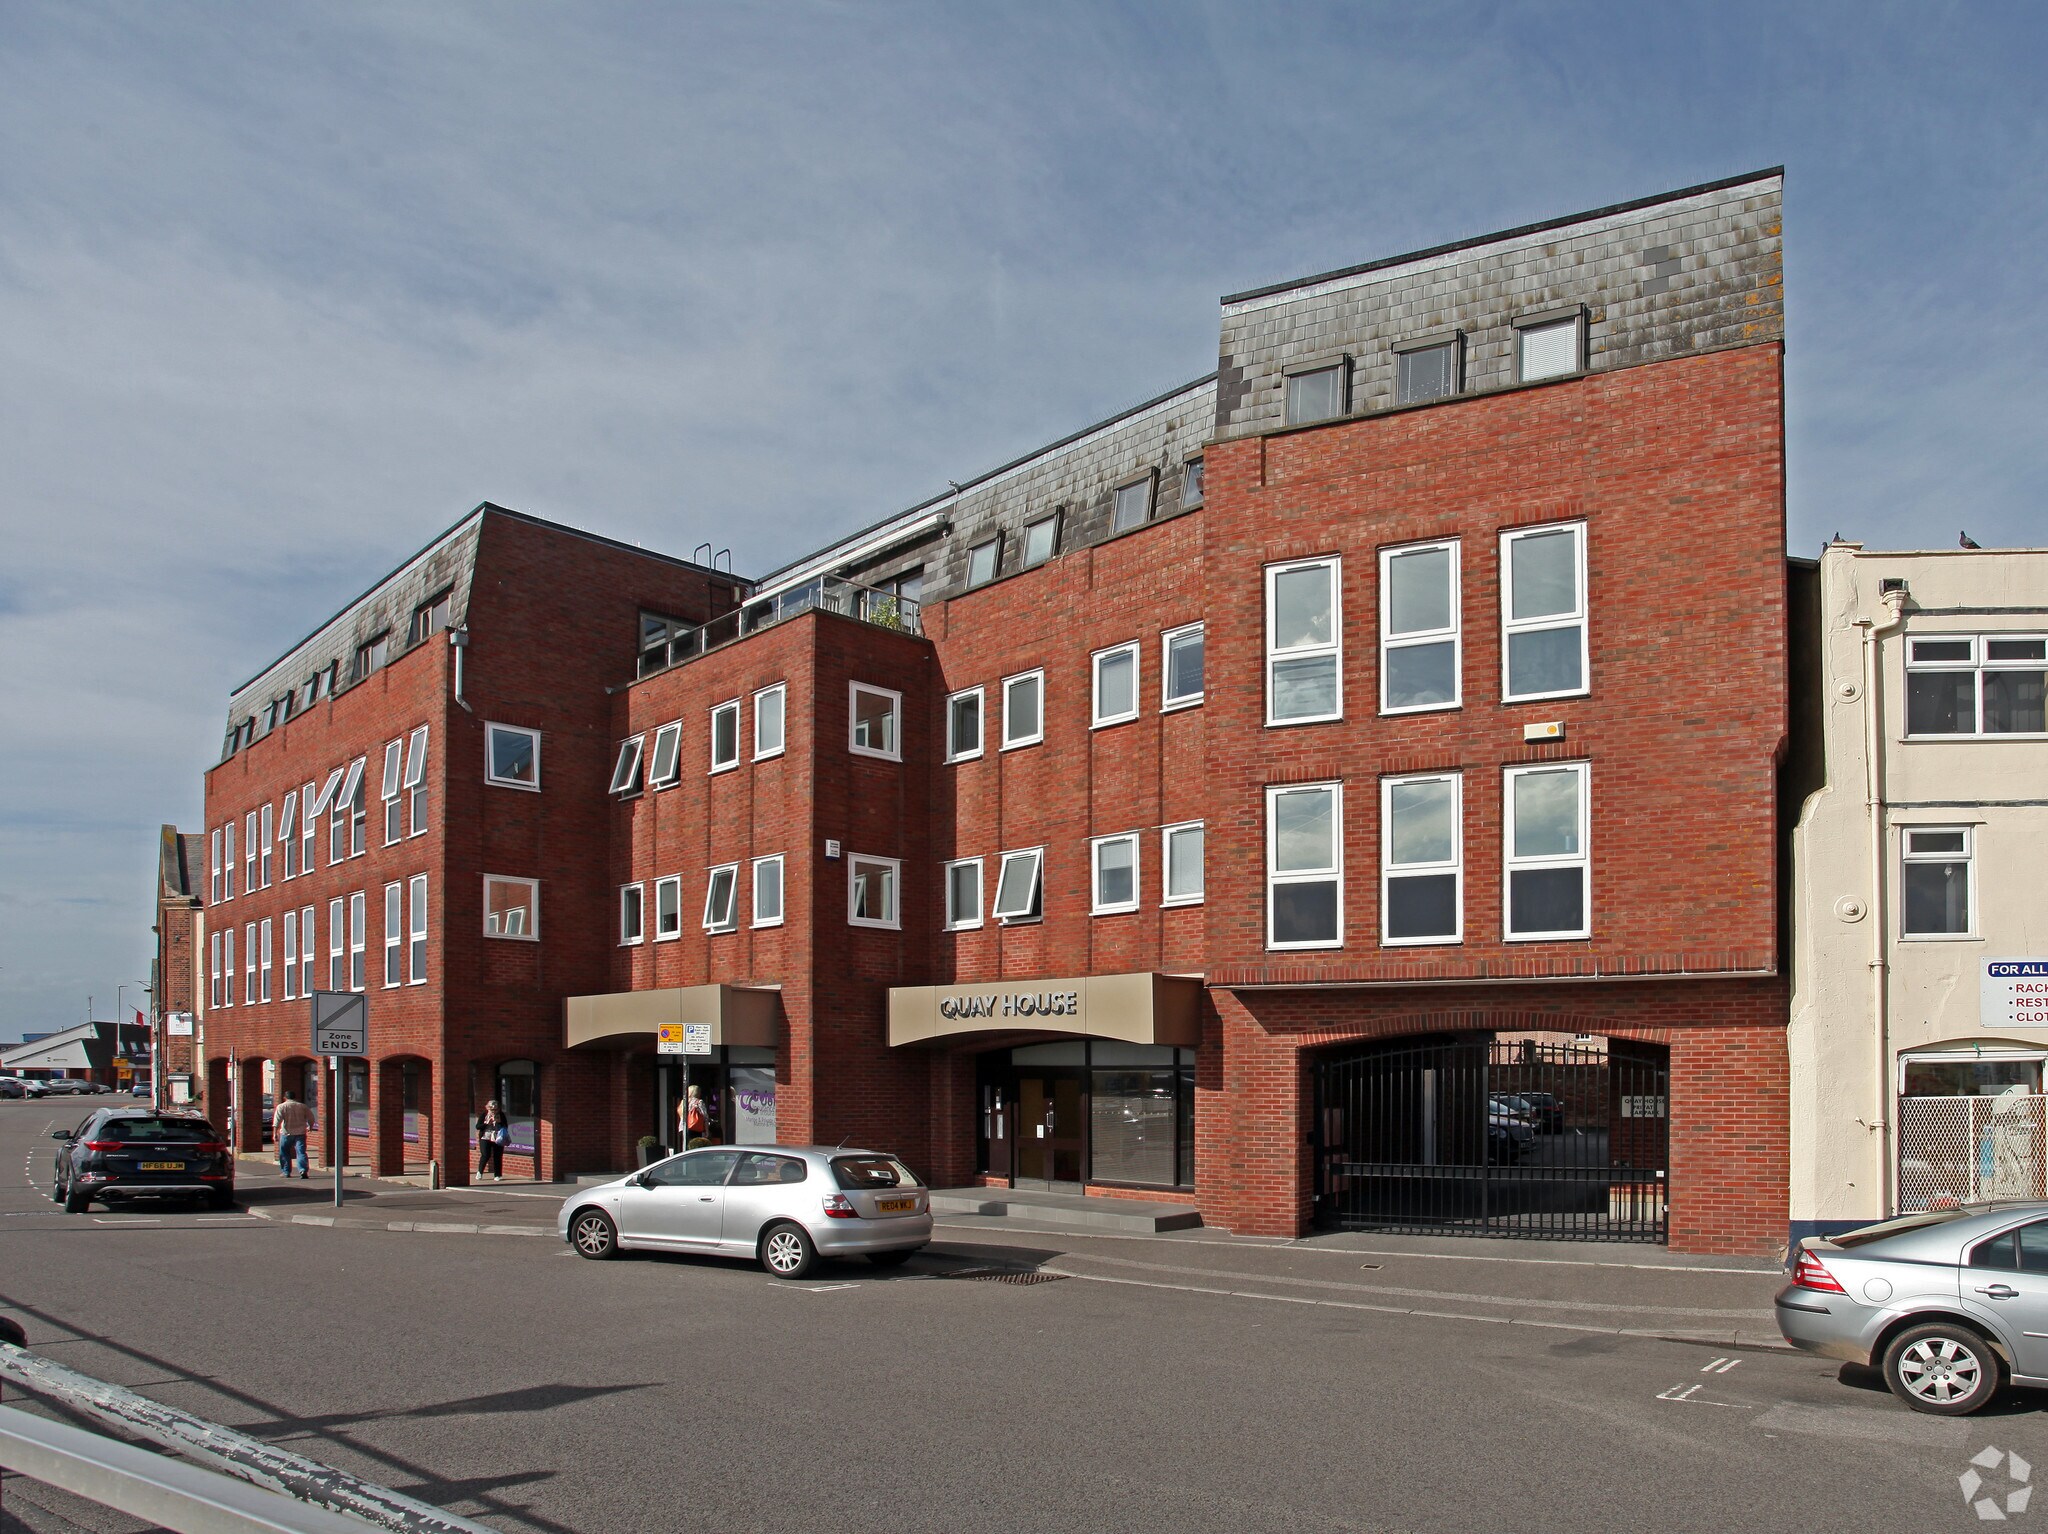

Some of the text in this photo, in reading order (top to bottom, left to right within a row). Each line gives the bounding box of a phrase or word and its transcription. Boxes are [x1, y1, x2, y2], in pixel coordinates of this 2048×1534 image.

[1991, 965, 2047, 975] FOR ALL
[940, 991, 1077, 1020] QUAY HOUSE
[329, 1032, 352, 1040] Zone
[322, 1041, 358, 1049] ENDS
[882, 1201, 899, 1210] RE04
